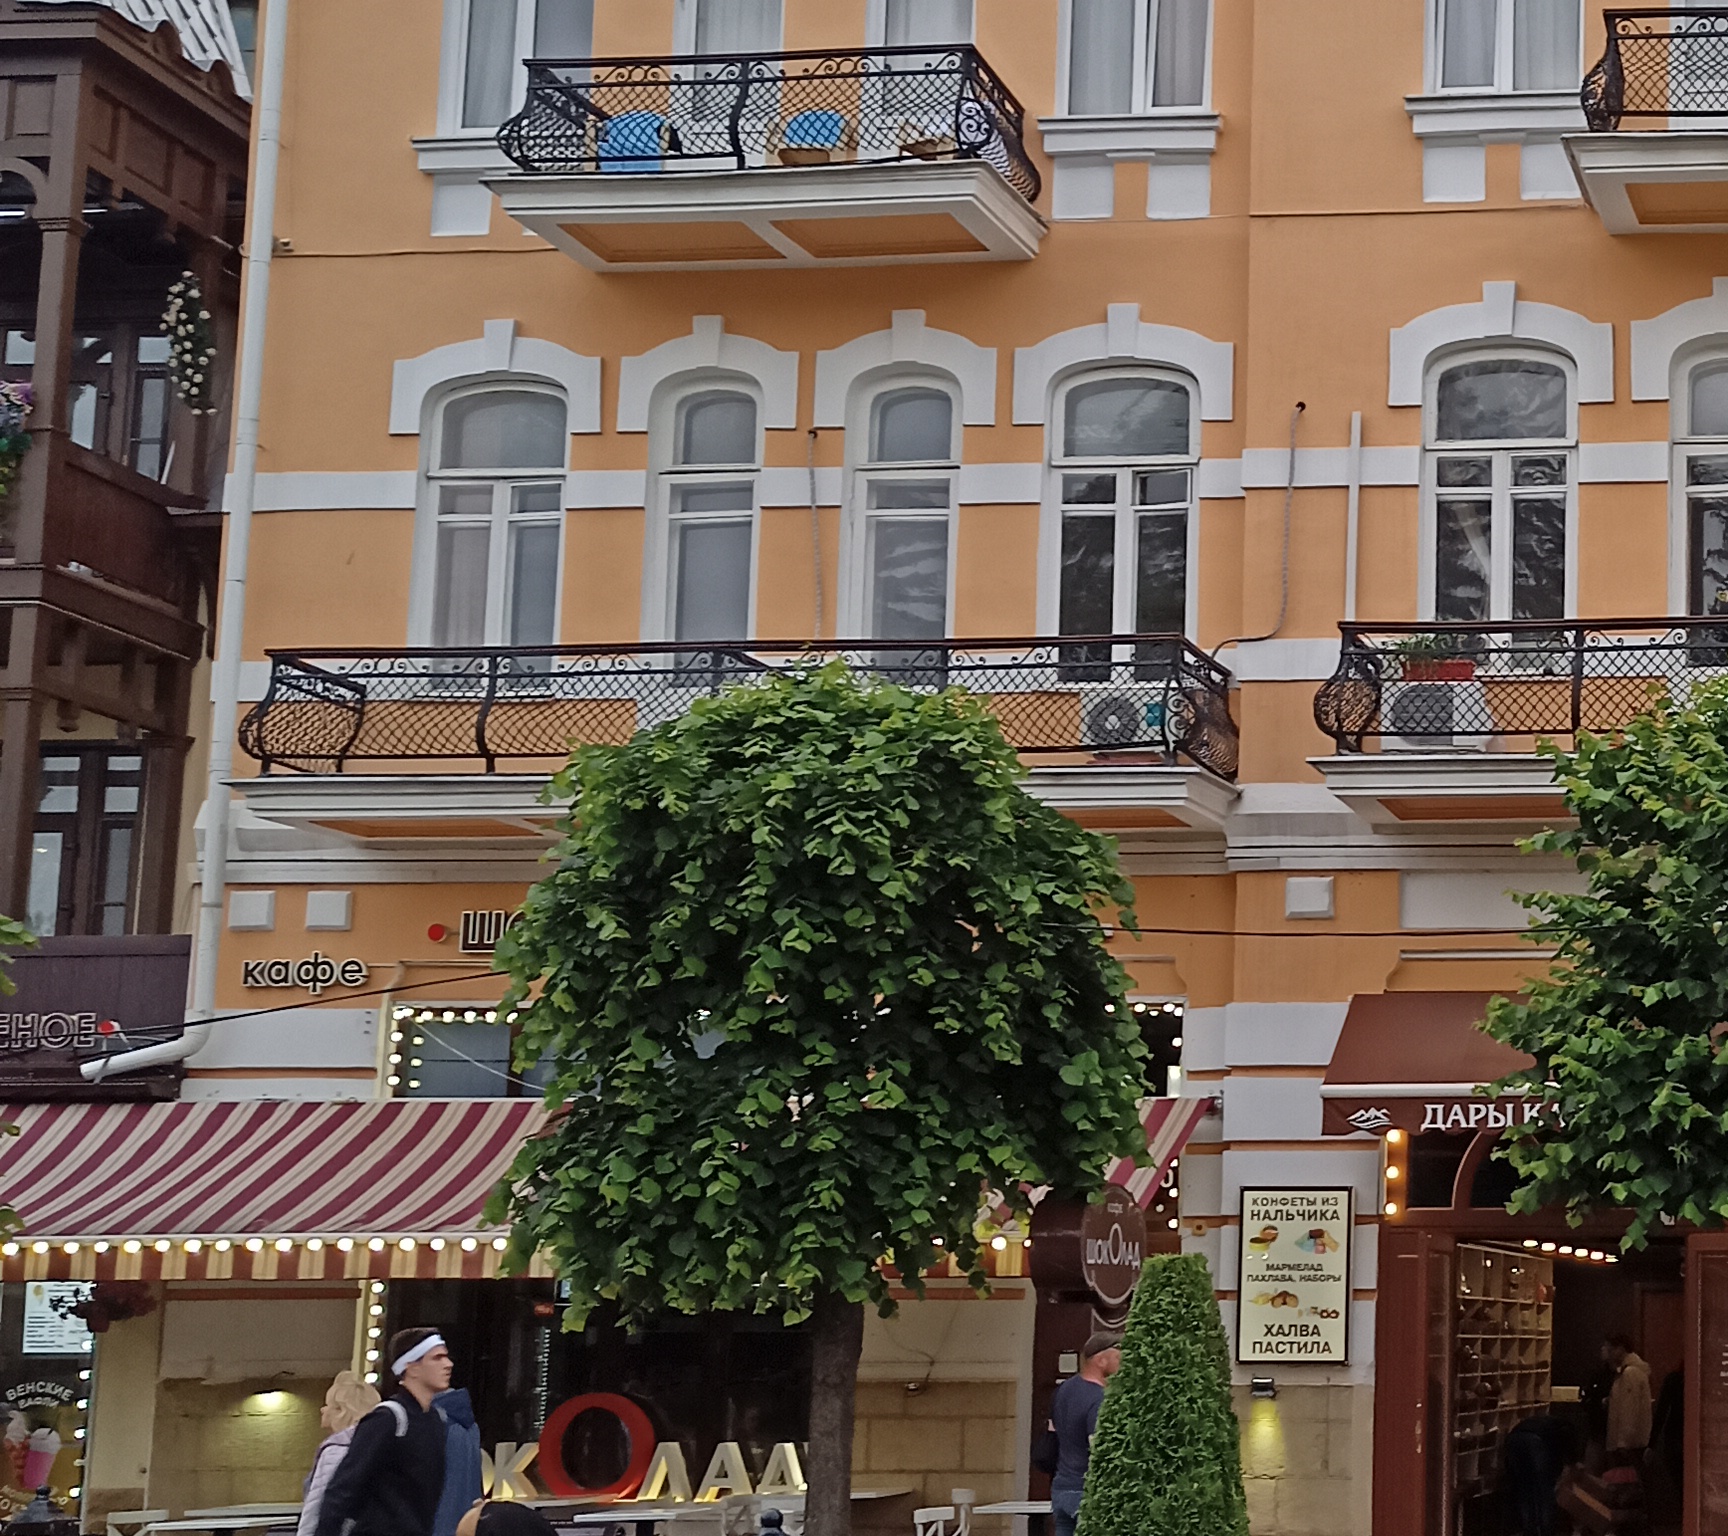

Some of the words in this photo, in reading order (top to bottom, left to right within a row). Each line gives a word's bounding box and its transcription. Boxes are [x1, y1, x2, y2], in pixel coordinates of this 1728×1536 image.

[242, 951, 368, 995] кафе
[1420, 1103, 1514, 1132] ДАРЫ
[1251, 1197, 1317, 1207] КОНФЕТЫ
[1321, 1197, 1339, 1207] ИЗ
[1249, 1209, 1341, 1221] НАЛЬЧИКА
[1265, 1263, 1324, 1272] МАРМЕЛАД
[1298, 1274, 1342, 1283] НАБОРЫ
[1263, 1324, 1322, 1337] ХАЛВА
[1251, 1341, 1333, 1355] ПАСТИЛА
[5, 1380, 75, 1402] ВЕНСКИЕ
